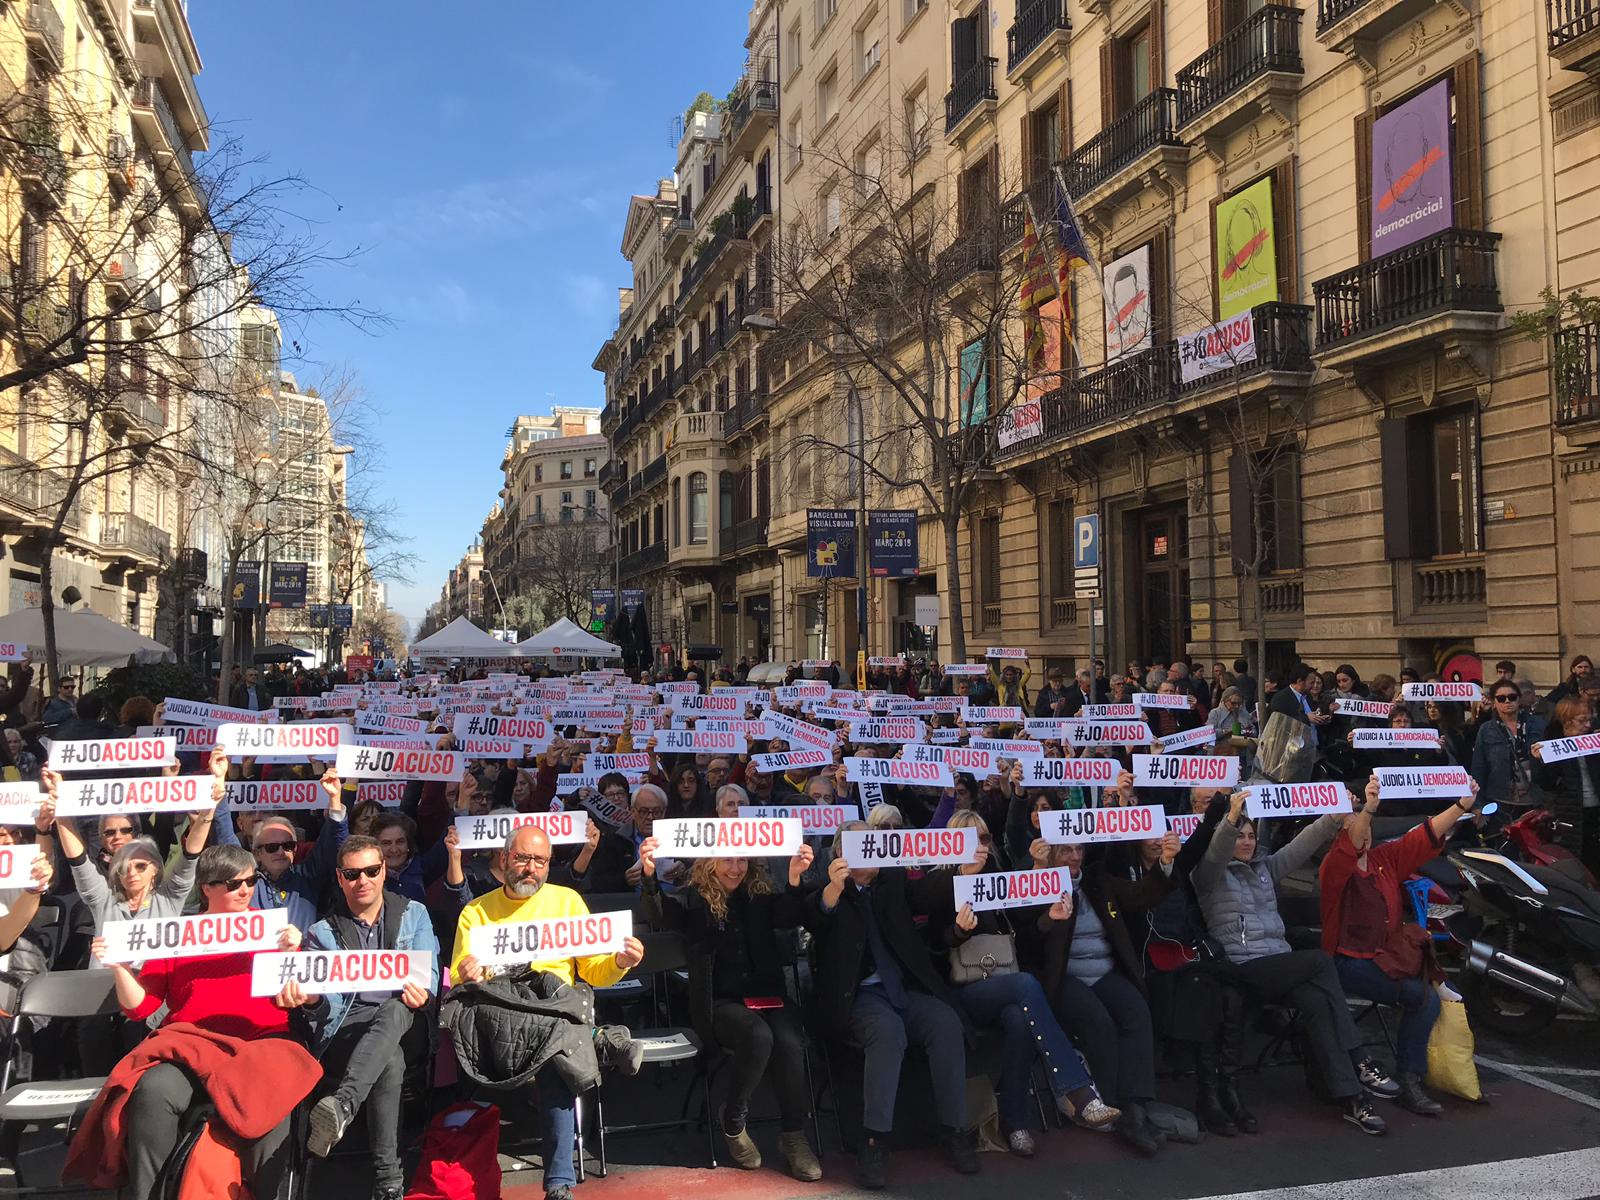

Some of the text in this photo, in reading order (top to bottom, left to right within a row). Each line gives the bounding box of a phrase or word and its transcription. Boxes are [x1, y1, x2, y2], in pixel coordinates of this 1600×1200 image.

[1182, 316, 1251, 365] #JOACUSO
[809, 520, 854, 528] VISUALSOUND
[875, 539, 893, 548] MARÇ
[1079, 522, 1093, 561] P
[525, 689, 566, 701] #JOACUSO
[662, 684, 695, 693] #JOACUSO
[782, 687, 825, 697] #JOACUSO
[1411, 684, 1473, 697] #JOACUSO
[312, 697, 352, 708] #JOACUSO
[683, 696, 736, 710] #JOACUSO
[1140, 695, 1182, 705] #JOACUSO
[167, 703, 192, 716] JUDICI
[199, 708, 209, 717] LA
[373, 705, 412, 714] #JOACUSO
[968, 707, 1014, 718] #JOACUSO
[1089, 704, 1136, 717] #JOACUSO
[363, 713, 420, 732] #JOACUSO
[468, 716, 545, 739] #JOACUSO
[706, 721, 765, 736] #JOACUSO
[237, 727, 339, 748] #JOACUSO
[666, 731, 735, 748] #JOACUSO
[859, 724, 915, 739] #JOACUSO
[1075, 725, 1144, 742] #JOACUSO
[1357, 732, 1378, 741] JUDICI
[1385, 732, 1393, 740] LA
[61, 740, 165, 763] #JOACUSO
[973, 742, 990, 750] JUDICI
[997, 742, 1004, 750] LA
[355, 750, 455, 775] #JOACUSO
[595, 754, 650, 770] #JOACUSO
[765, 751, 826, 767] #JOACUSO
[915, 746, 989, 768] #JOACUSO
[860, 759, 940, 780] #JOACUSO
[1034, 759, 1112, 779] #JOACUSO
[1149, 757, 1227, 780] #JOACUSO
[558, 777, 579, 787] JUDICI
[586, 777, 595, 786] LA
[1381, 773, 1405, 787] JUDICI
[1413, 773, 1422, 786] LA
[79, 780, 196, 807] #JOACUSO
[357, 783, 406, 801] ACUSO
[1261, 784, 1338, 809] #JOACUSO
[1059, 808, 1152, 836] #JOACUSO
[674, 821, 784, 847] #JOACUSO
[861, 831, 964, 859] #JOACUSO
[973, 871, 1060, 902] #JOACUSO
[127, 914, 264, 951] #JOACUSO
[493, 917, 611, 955] #JOACUSO
[278, 953, 409, 984] #JOACUSO
